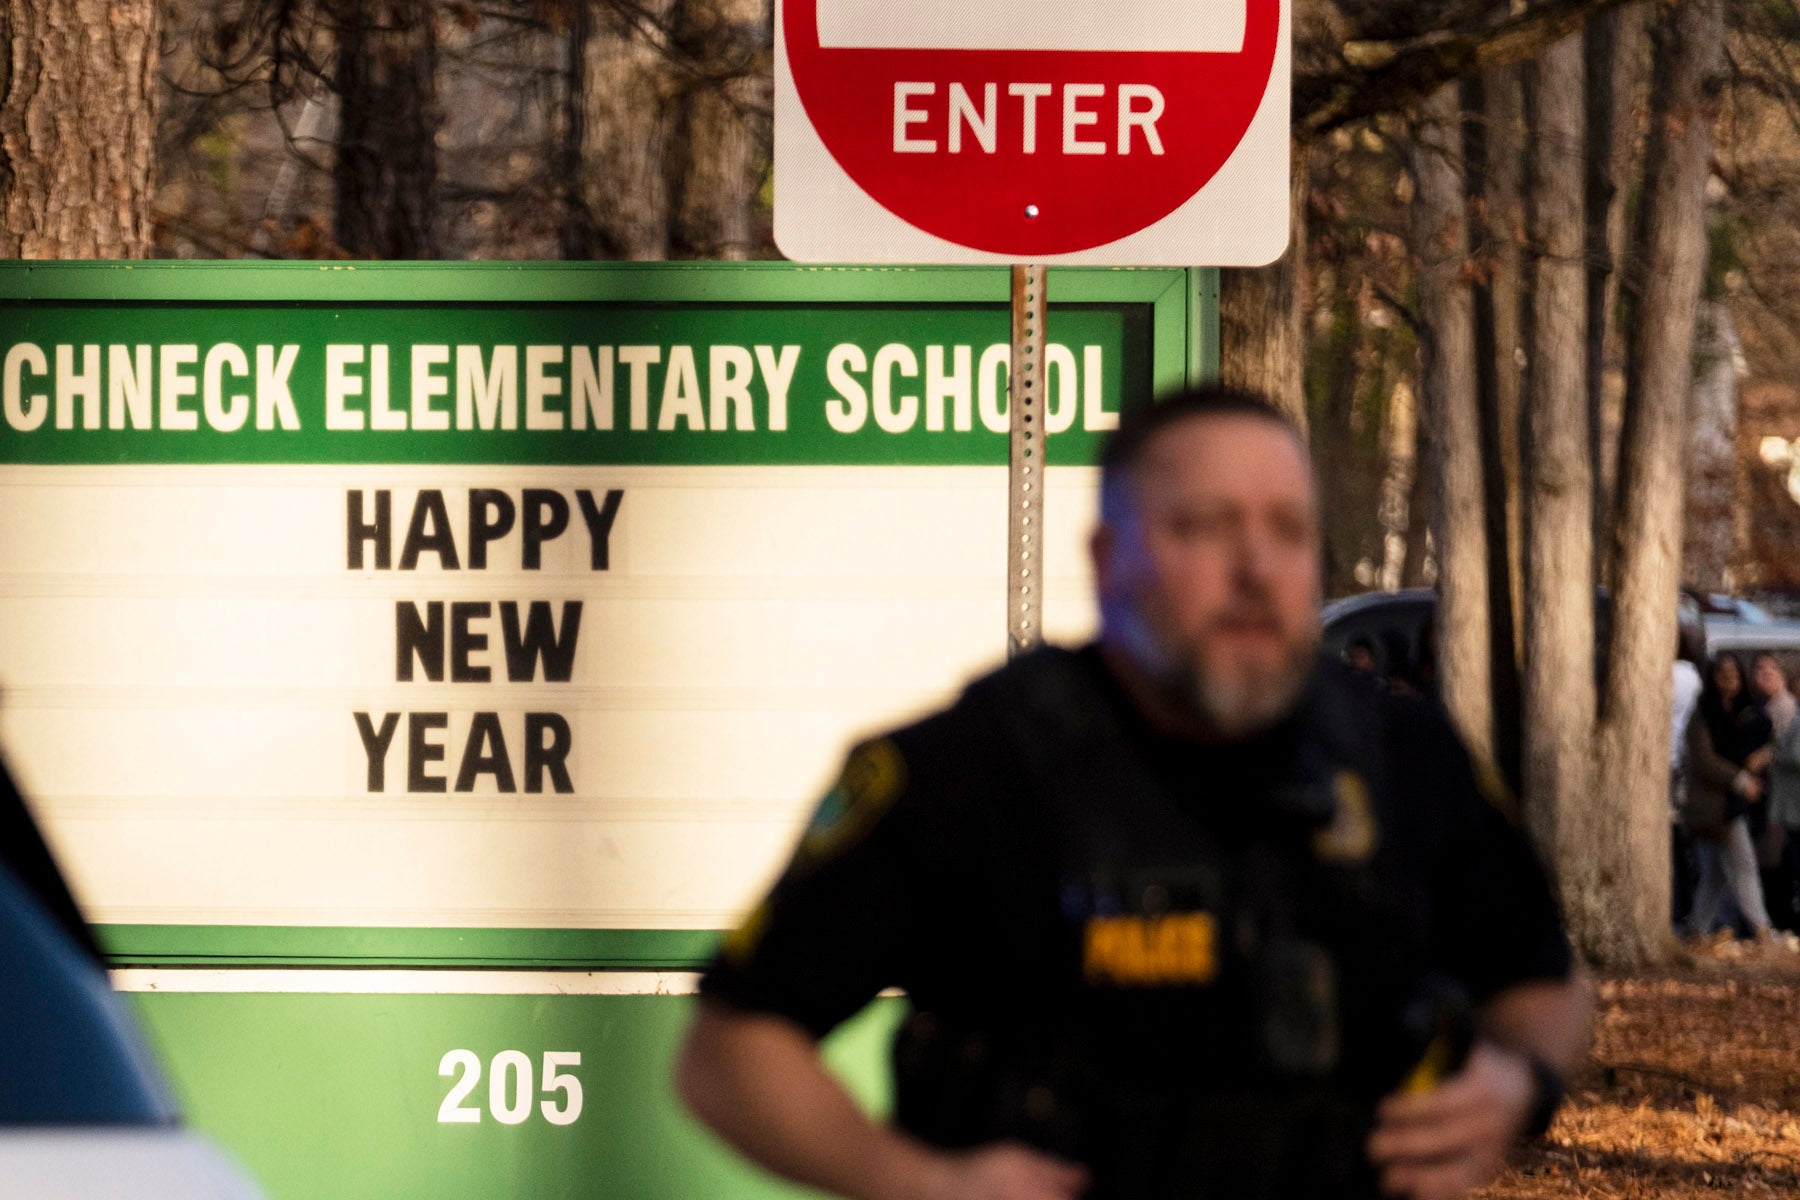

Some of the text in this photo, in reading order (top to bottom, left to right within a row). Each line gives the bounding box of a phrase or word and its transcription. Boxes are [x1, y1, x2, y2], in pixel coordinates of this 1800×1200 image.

[893, 81, 1166, 156] ENTER
[325, 343, 801, 432] ELEMENTARY
[825, 343, 1121, 433] SCHOOL
[347, 488, 625, 571] HAPPY
[396, 600, 584, 683] NEW
[355, 712, 575, 794] YEAR
[1085, 914, 1216, 984] POLICE
[437, 1049, 584, 1125] 205
